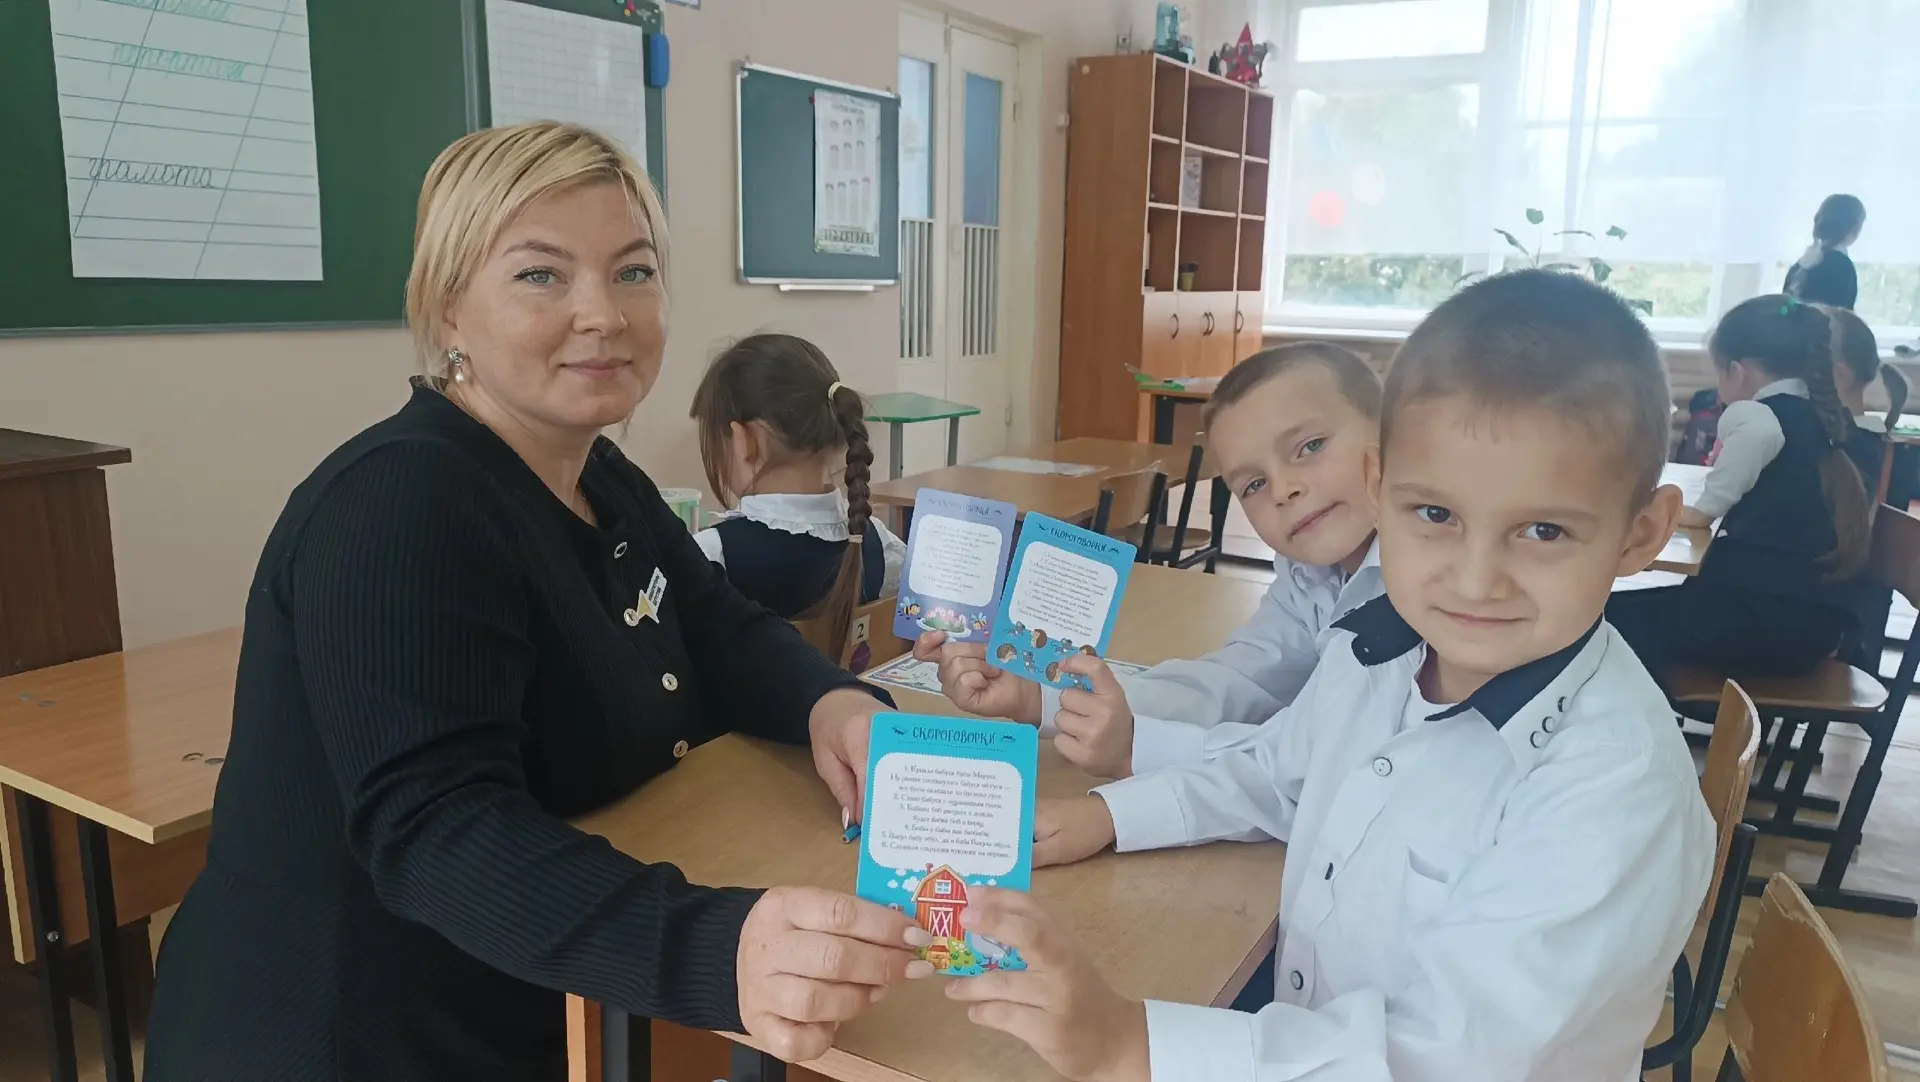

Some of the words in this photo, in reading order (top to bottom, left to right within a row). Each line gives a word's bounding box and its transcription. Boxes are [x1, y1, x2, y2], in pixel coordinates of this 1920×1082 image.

[88, 157, 216, 188] грамота
[1050, 527, 1108, 552] СКОРОГОВОРКИ
[857, 623, 864, 640] 2
[912, 726, 996, 746] СКОРОГОВОРКИ
